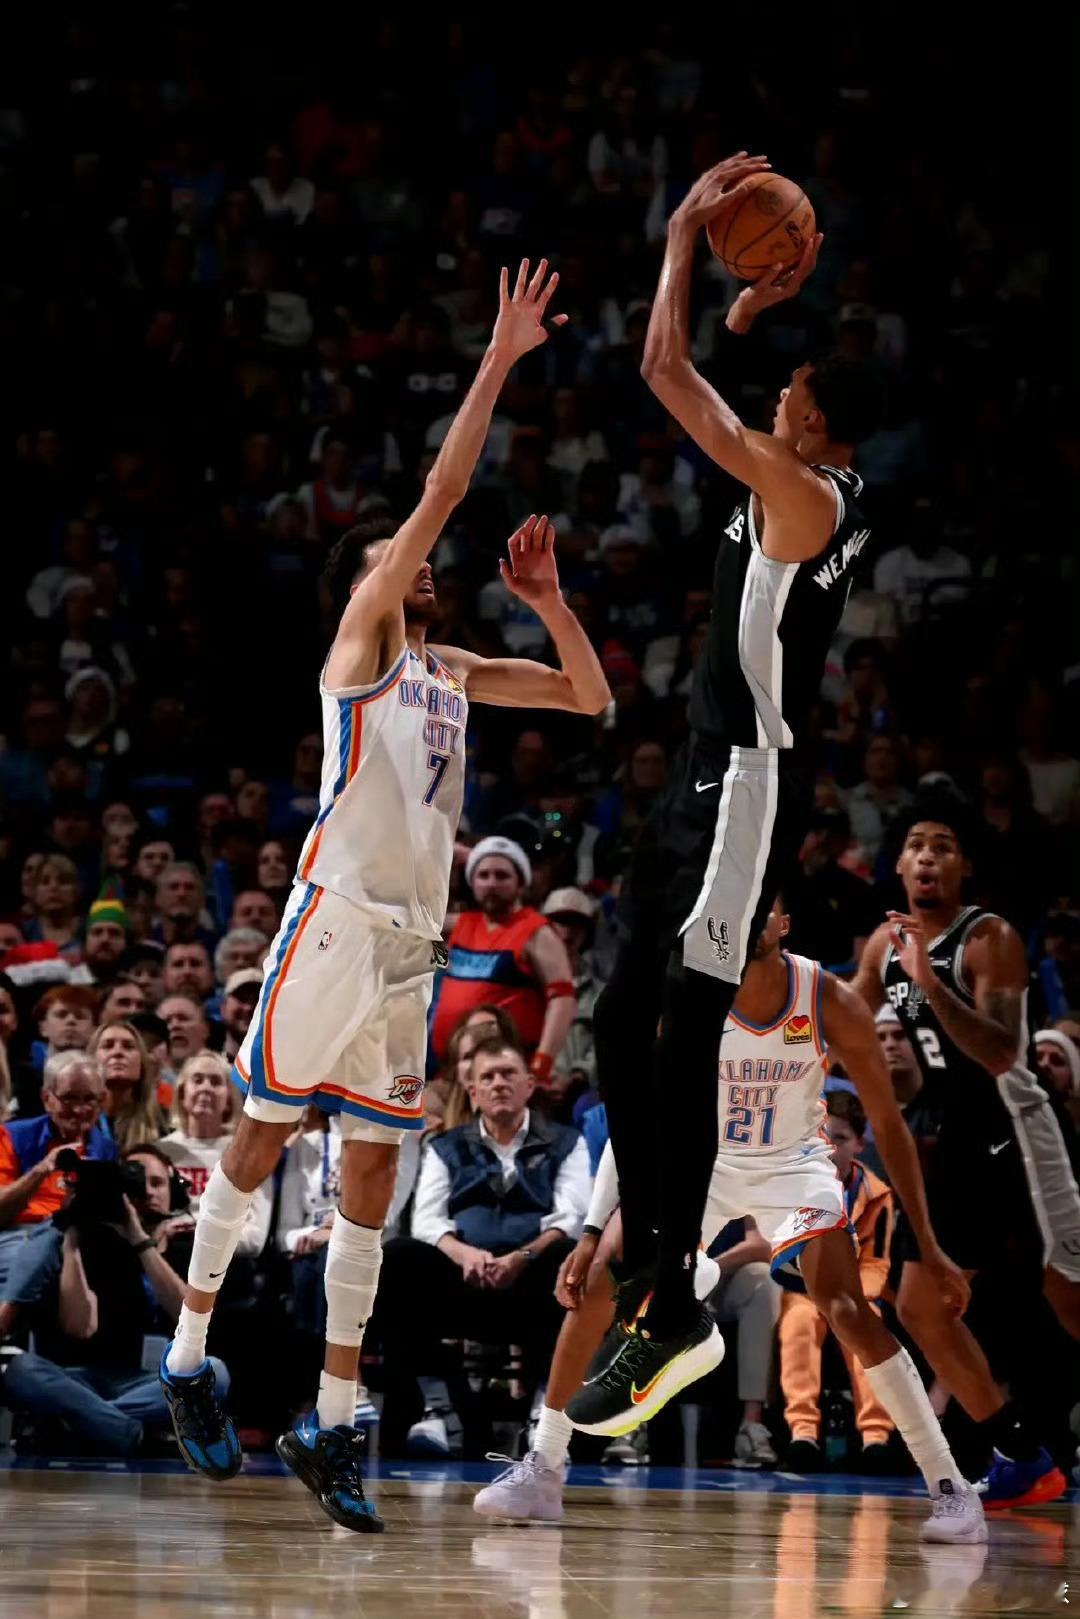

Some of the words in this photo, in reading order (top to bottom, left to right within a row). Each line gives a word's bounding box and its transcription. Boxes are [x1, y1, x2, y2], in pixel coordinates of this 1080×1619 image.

[399, 679, 461, 721] OKAHO
[422, 751, 450, 806] 7
[915, 1027, 946, 1069] 2
[728, 1085, 780, 1107] CITY
[725, 1105, 778, 1147] 21
